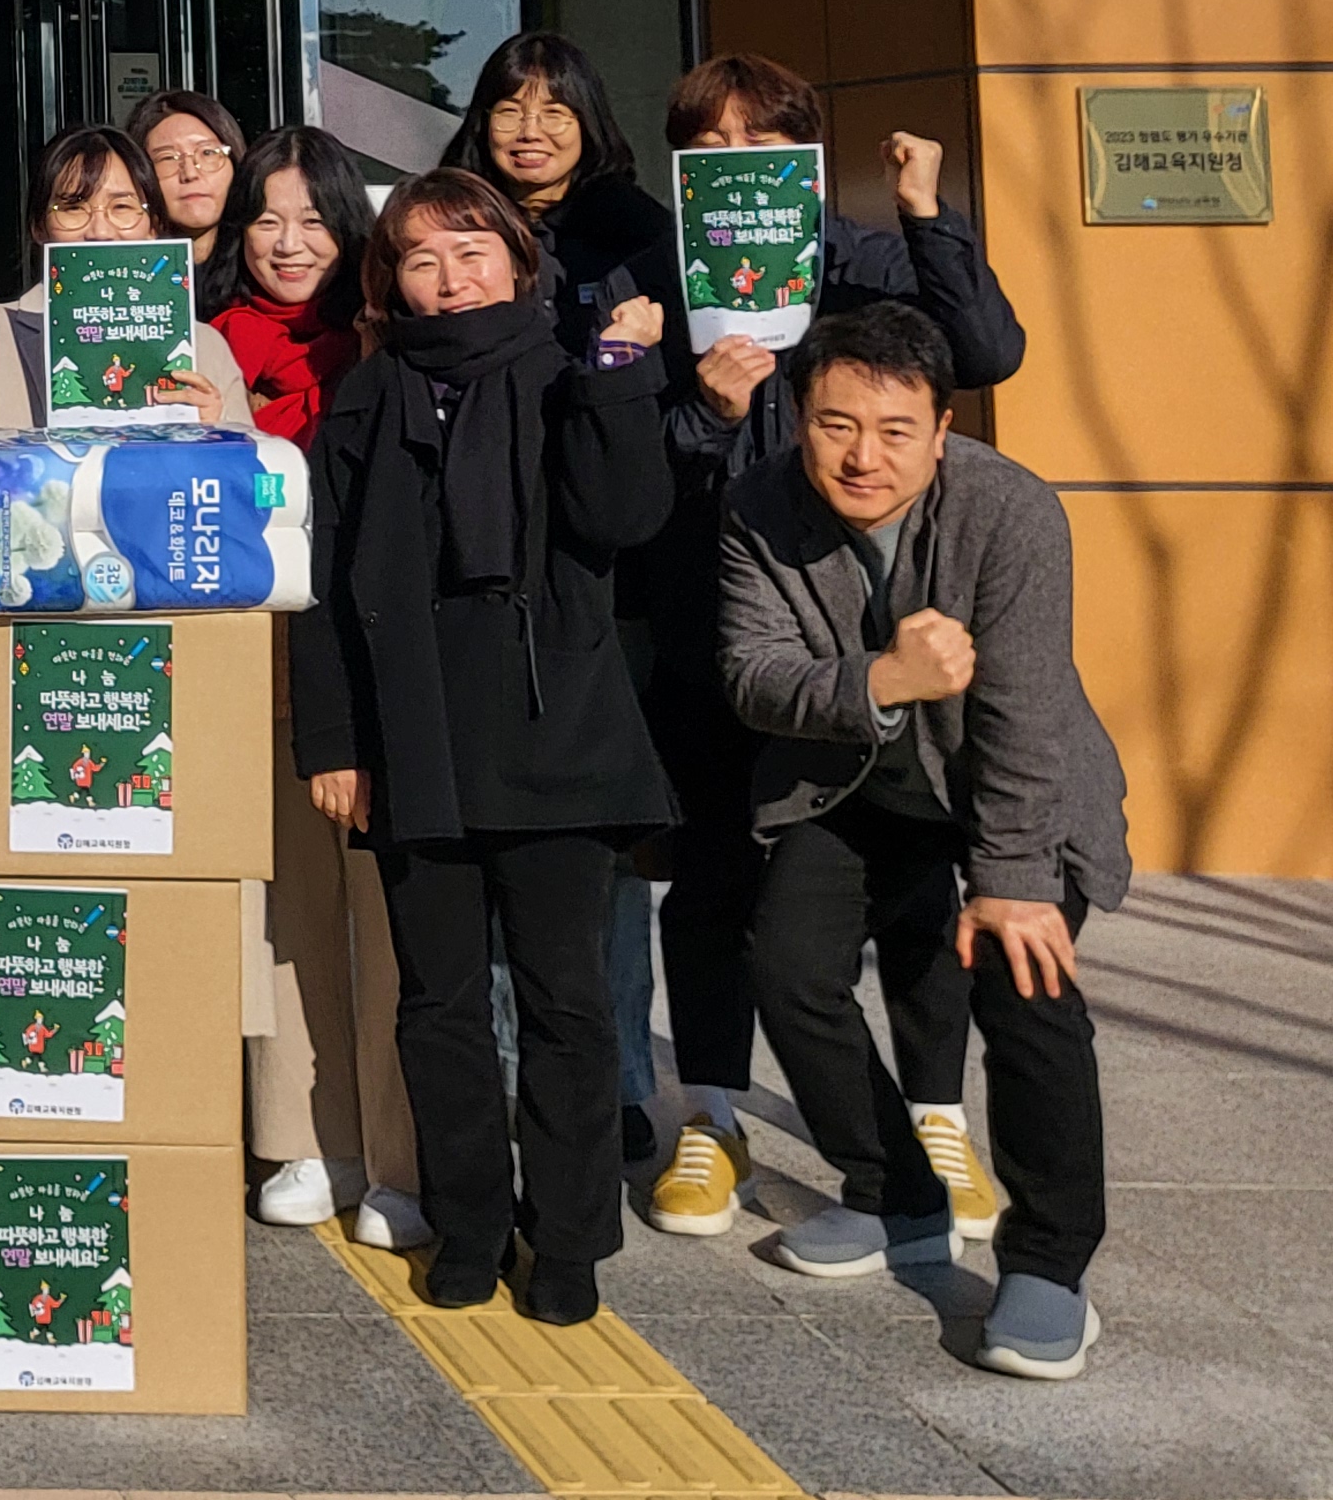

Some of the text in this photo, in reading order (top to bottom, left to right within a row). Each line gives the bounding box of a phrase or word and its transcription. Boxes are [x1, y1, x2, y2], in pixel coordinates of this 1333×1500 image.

[1114, 152, 1243, 172] 김해교육지원청
[73, 304, 172, 323] 따뜻하고 행복한
[76, 325, 104, 343] 연말
[167, 491, 186, 582] 데코&화이트
[190, 478, 222, 594] 모나리자
[39, 691, 150, 711] 따뜻하고 행복한
[43, 713, 74, 731] 연말
[57, 958, 104, 979] 행복한
[61, 1227, 108, 1246] 행복한
[1, 1249, 32, 1267] 연말
